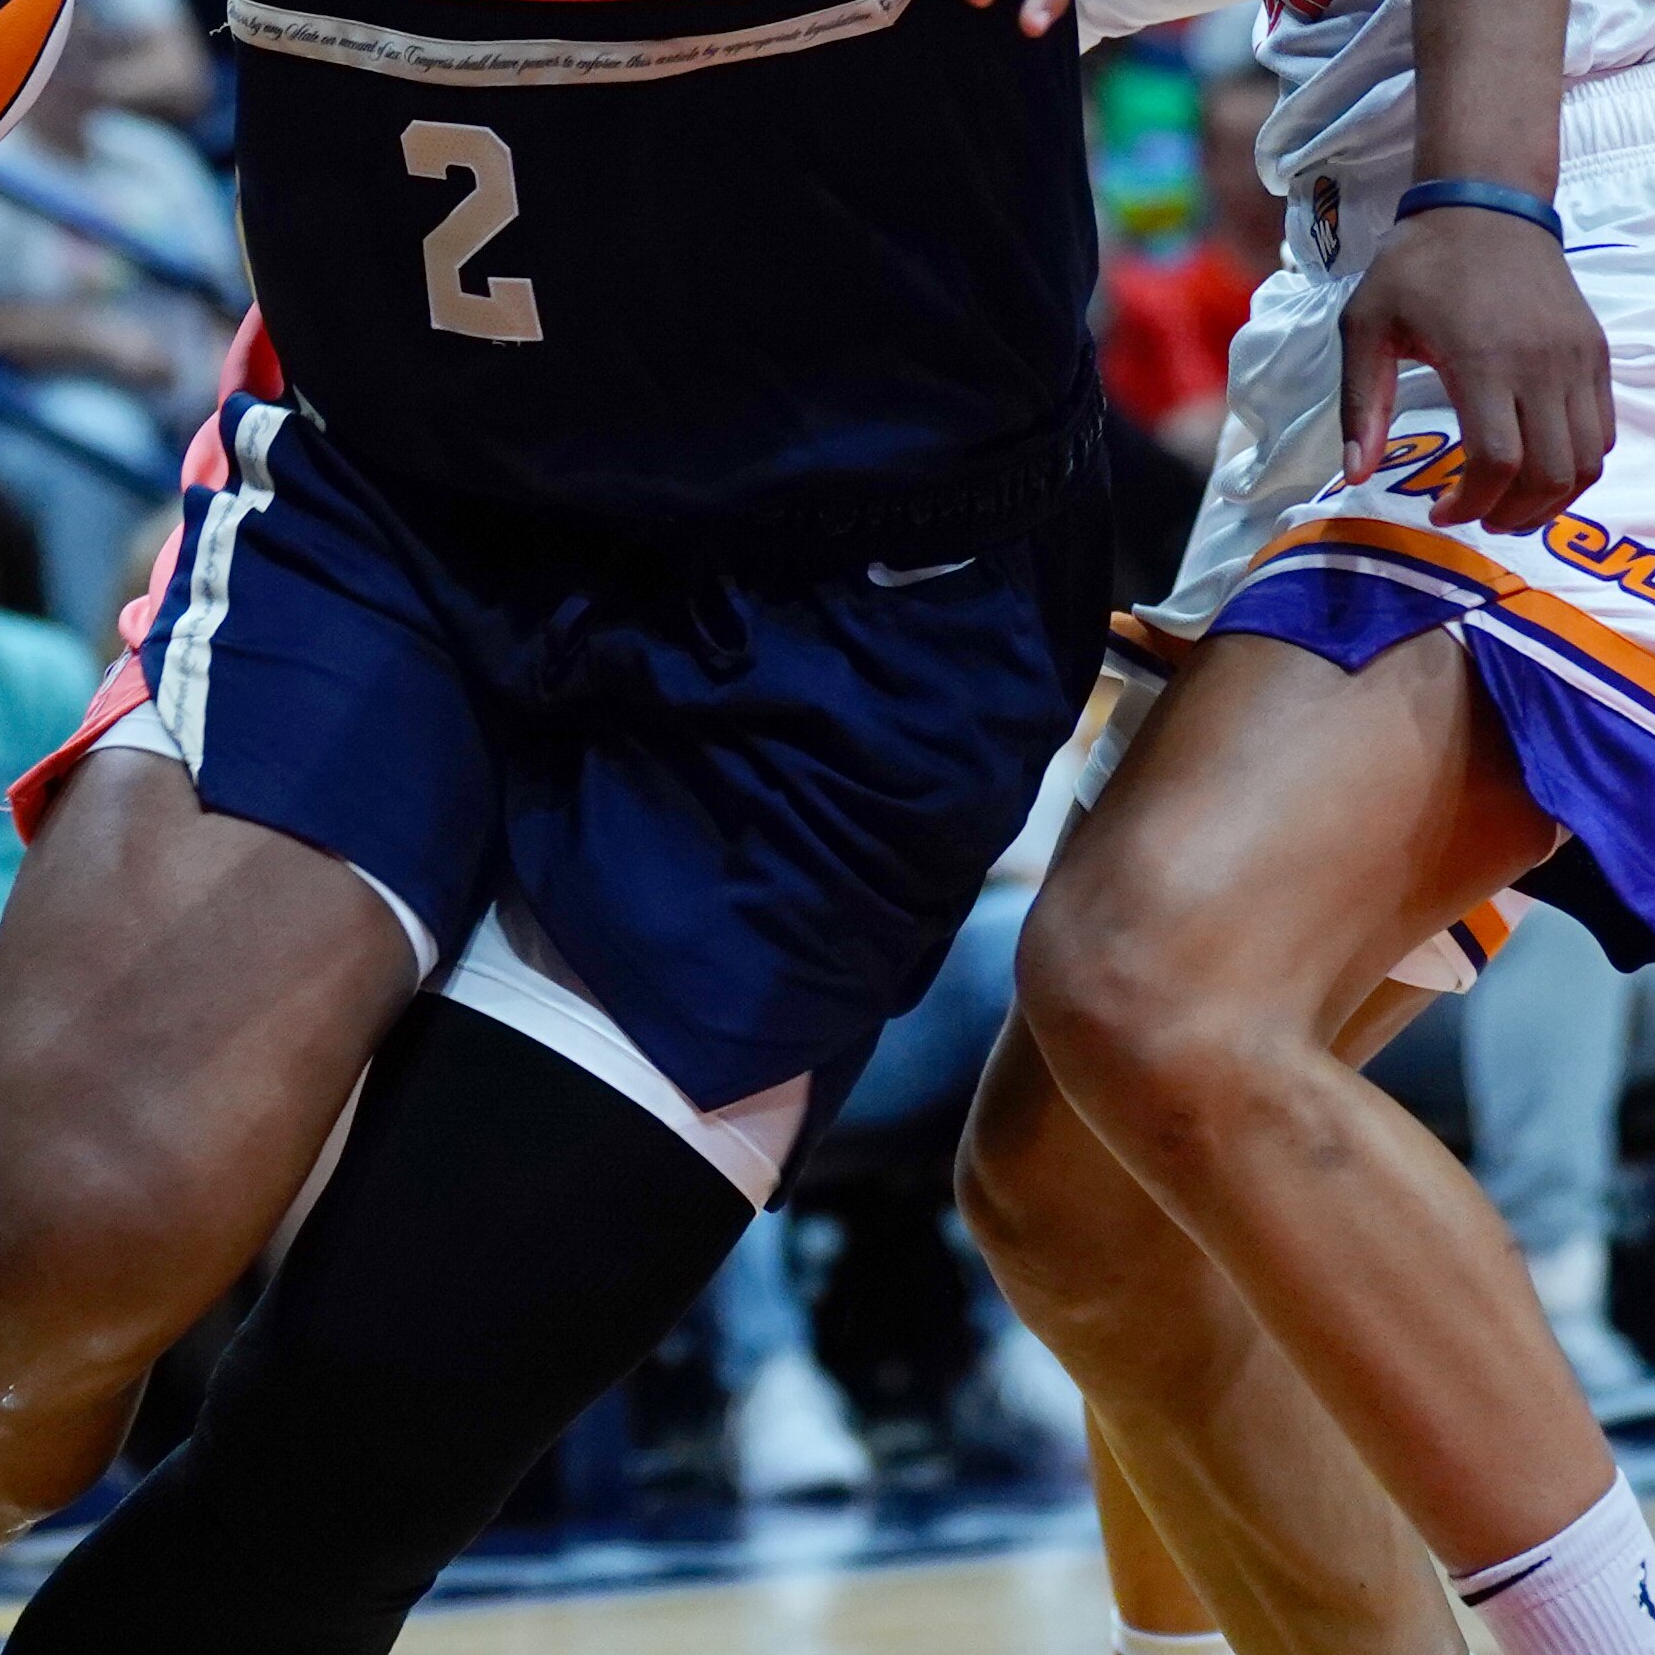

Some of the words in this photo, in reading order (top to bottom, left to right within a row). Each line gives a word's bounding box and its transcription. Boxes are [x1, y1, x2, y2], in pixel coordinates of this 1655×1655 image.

[284, 22, 320, 43] State
[403, 44, 455, 73] Congress
[400, 118, 544, 342] 2
